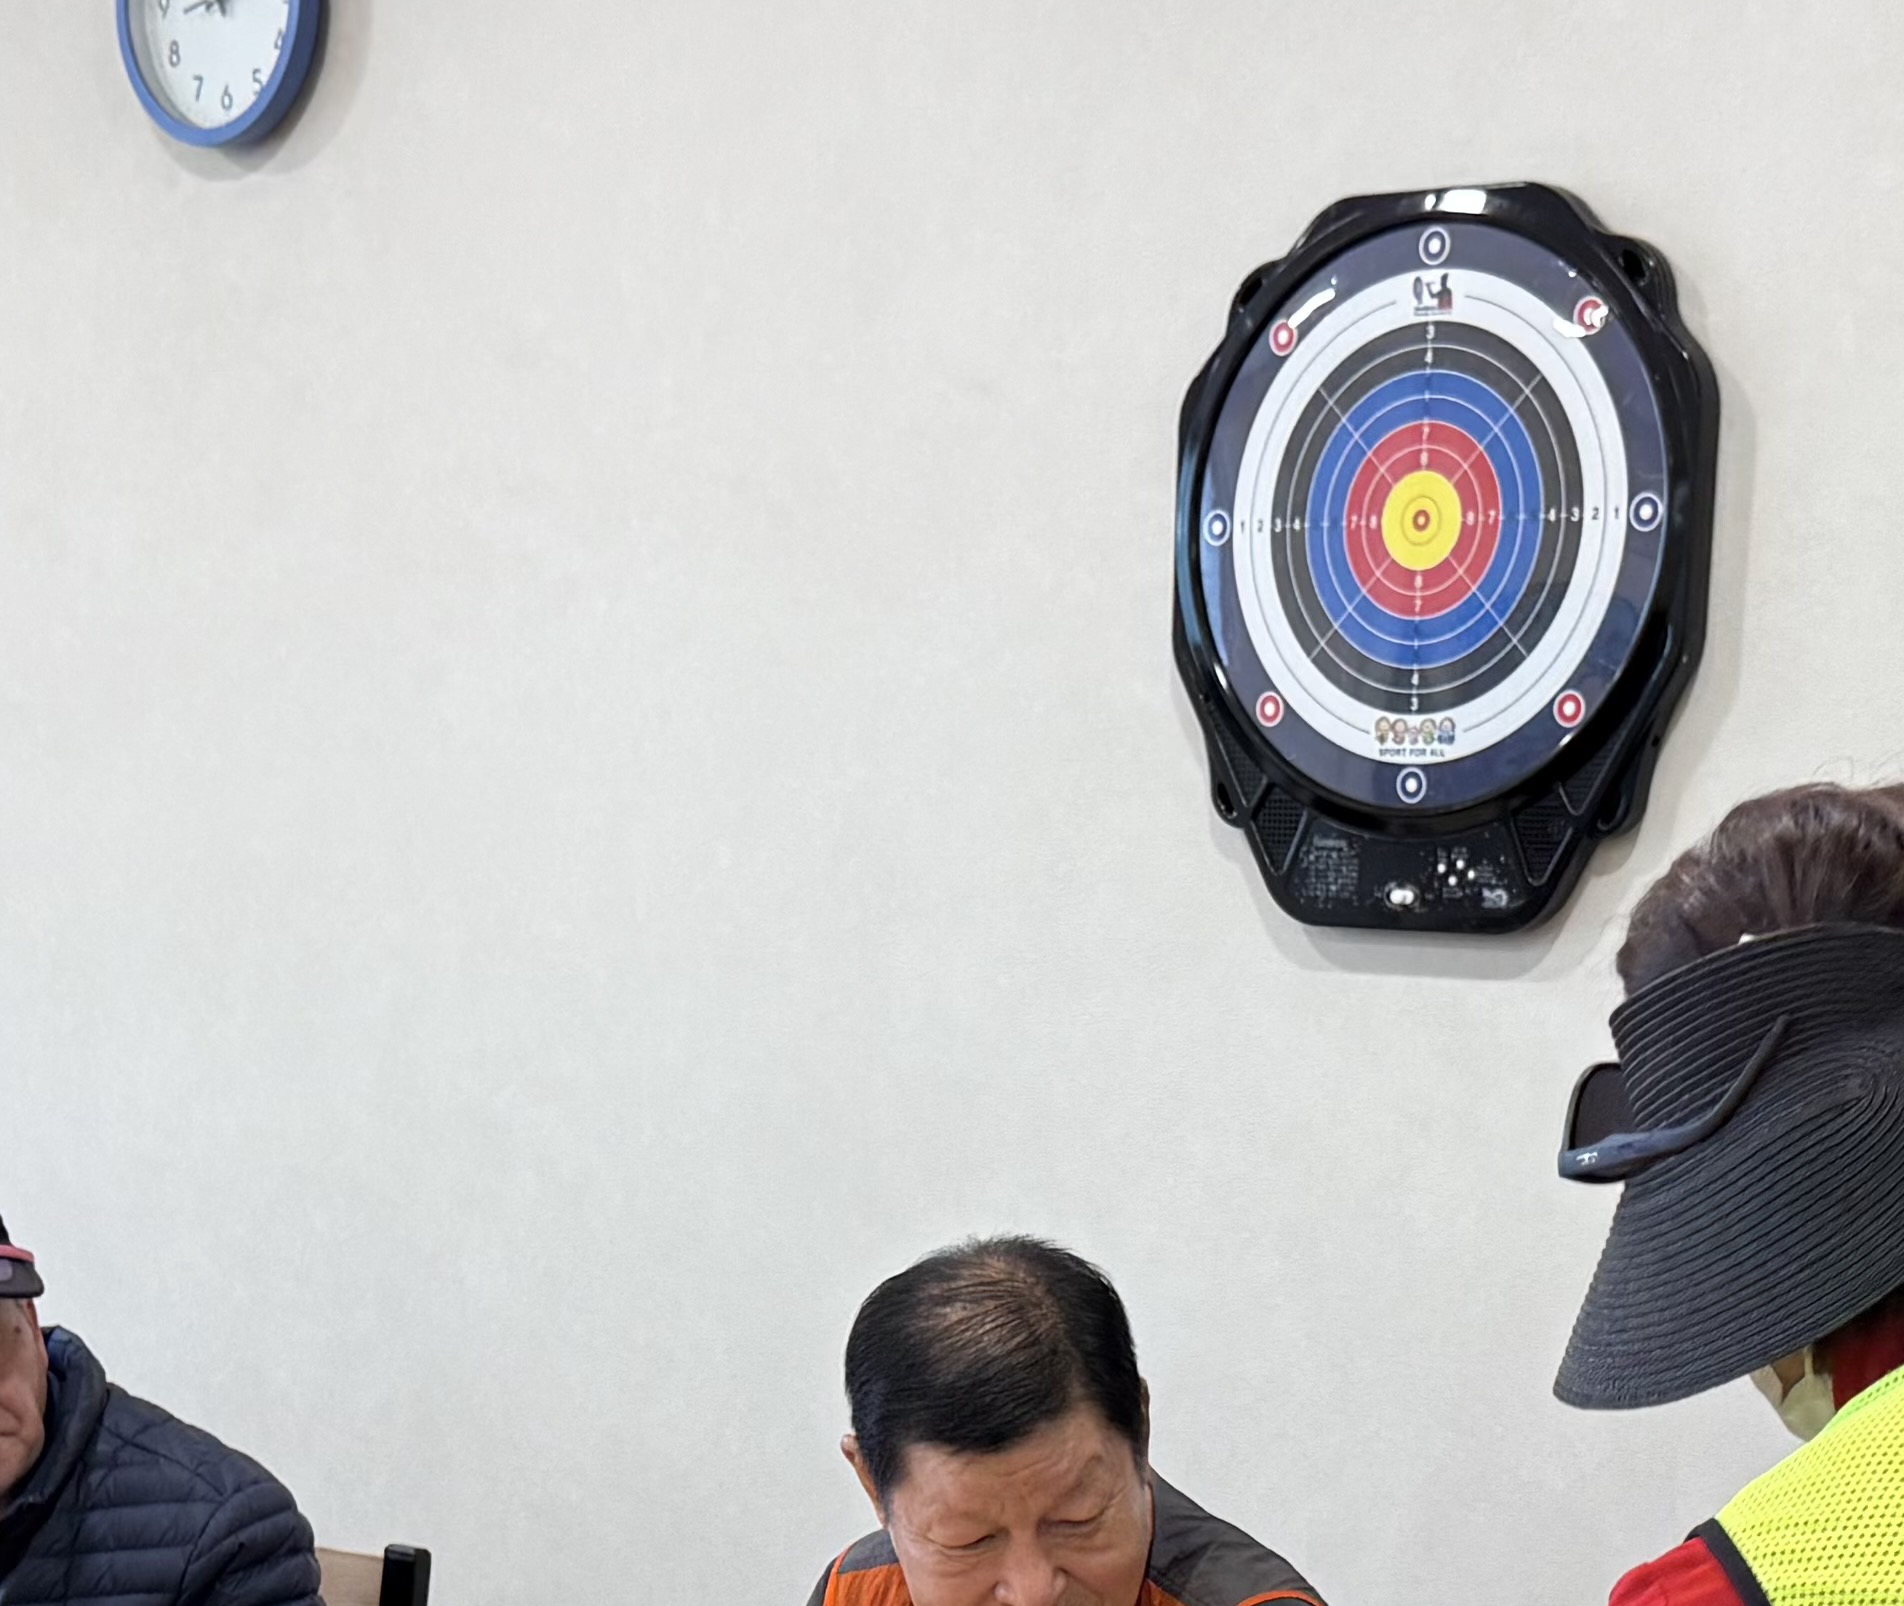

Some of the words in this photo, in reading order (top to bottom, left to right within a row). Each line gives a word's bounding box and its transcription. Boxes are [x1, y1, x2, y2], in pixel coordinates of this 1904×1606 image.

[168, 39, 181, 68] 8
[193, 74, 204, 102] 7
[252, 68, 265, 97] 5
[220, 84, 234, 111] 6
[1378, 747, 1407, 758] SPORT
[1409, 747, 1427, 758] FOR
